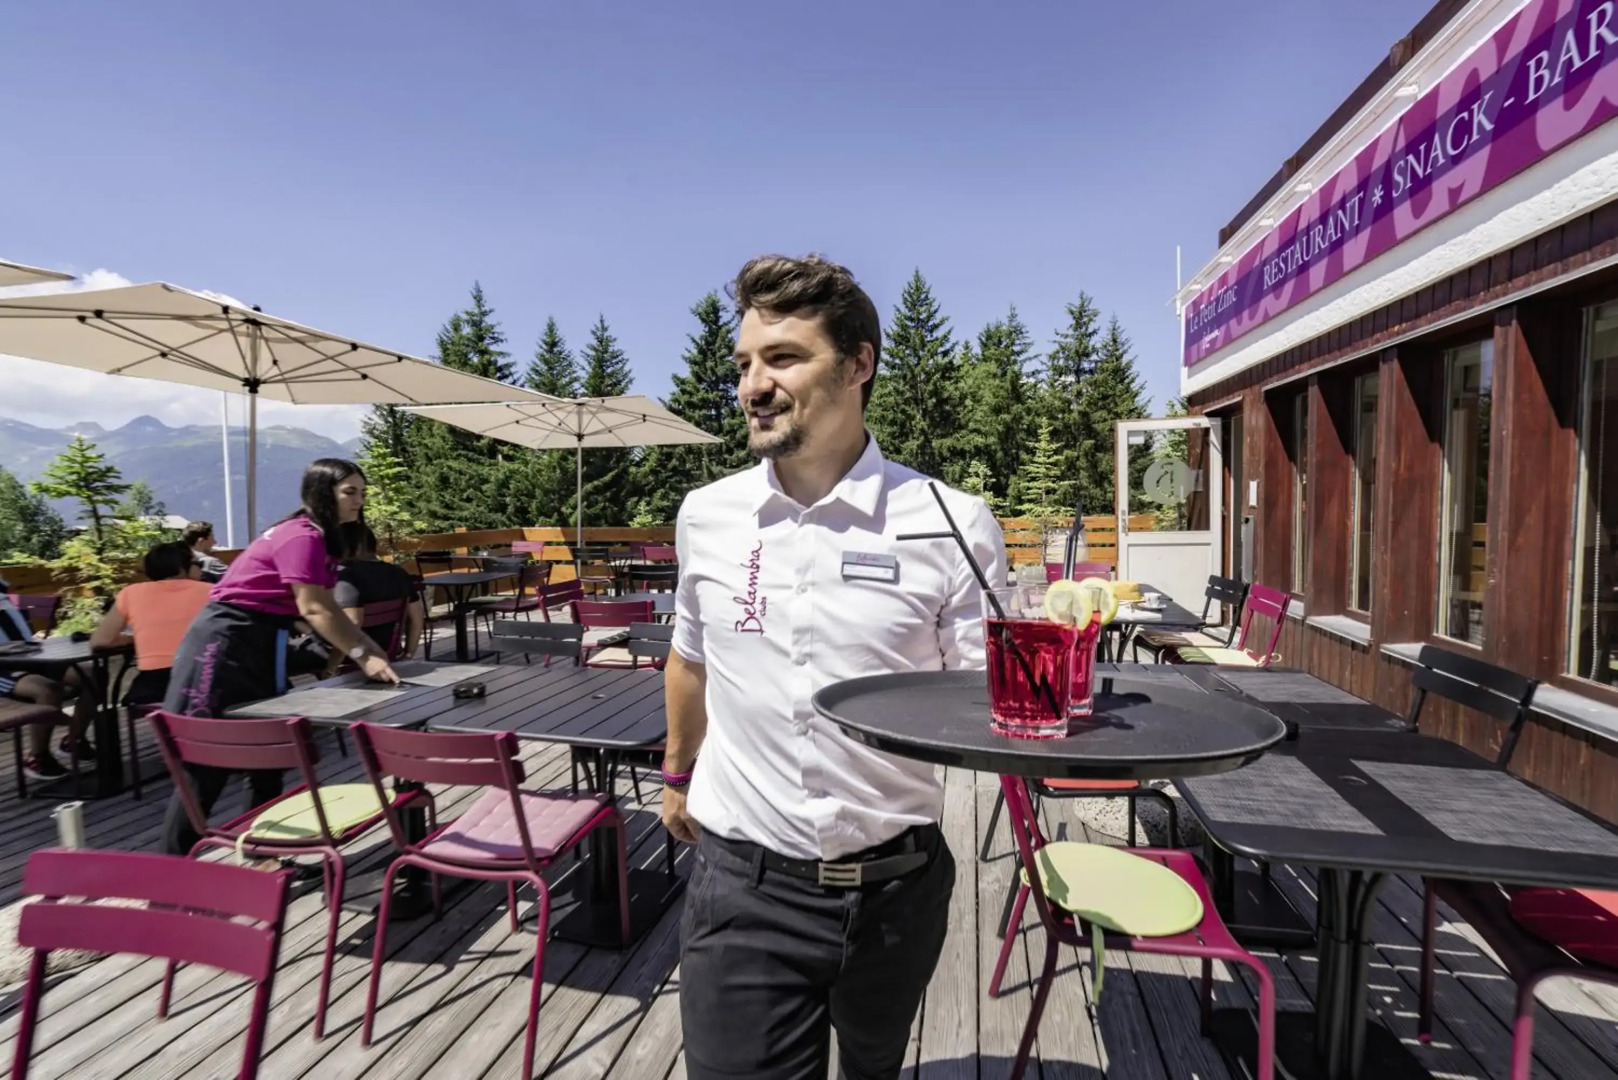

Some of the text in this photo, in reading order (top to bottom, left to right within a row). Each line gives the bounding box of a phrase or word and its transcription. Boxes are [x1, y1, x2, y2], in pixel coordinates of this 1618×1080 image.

[1263, 190, 1364, 290] RESTAURANT
[1392, 90, 1495, 197] SNACK
[1524, 1, 1618, 105] BAR
[1190, 312, 1198, 333] Le
[1218, 285, 1237, 313] Zinc
[733, 540, 763, 636] Belambra
